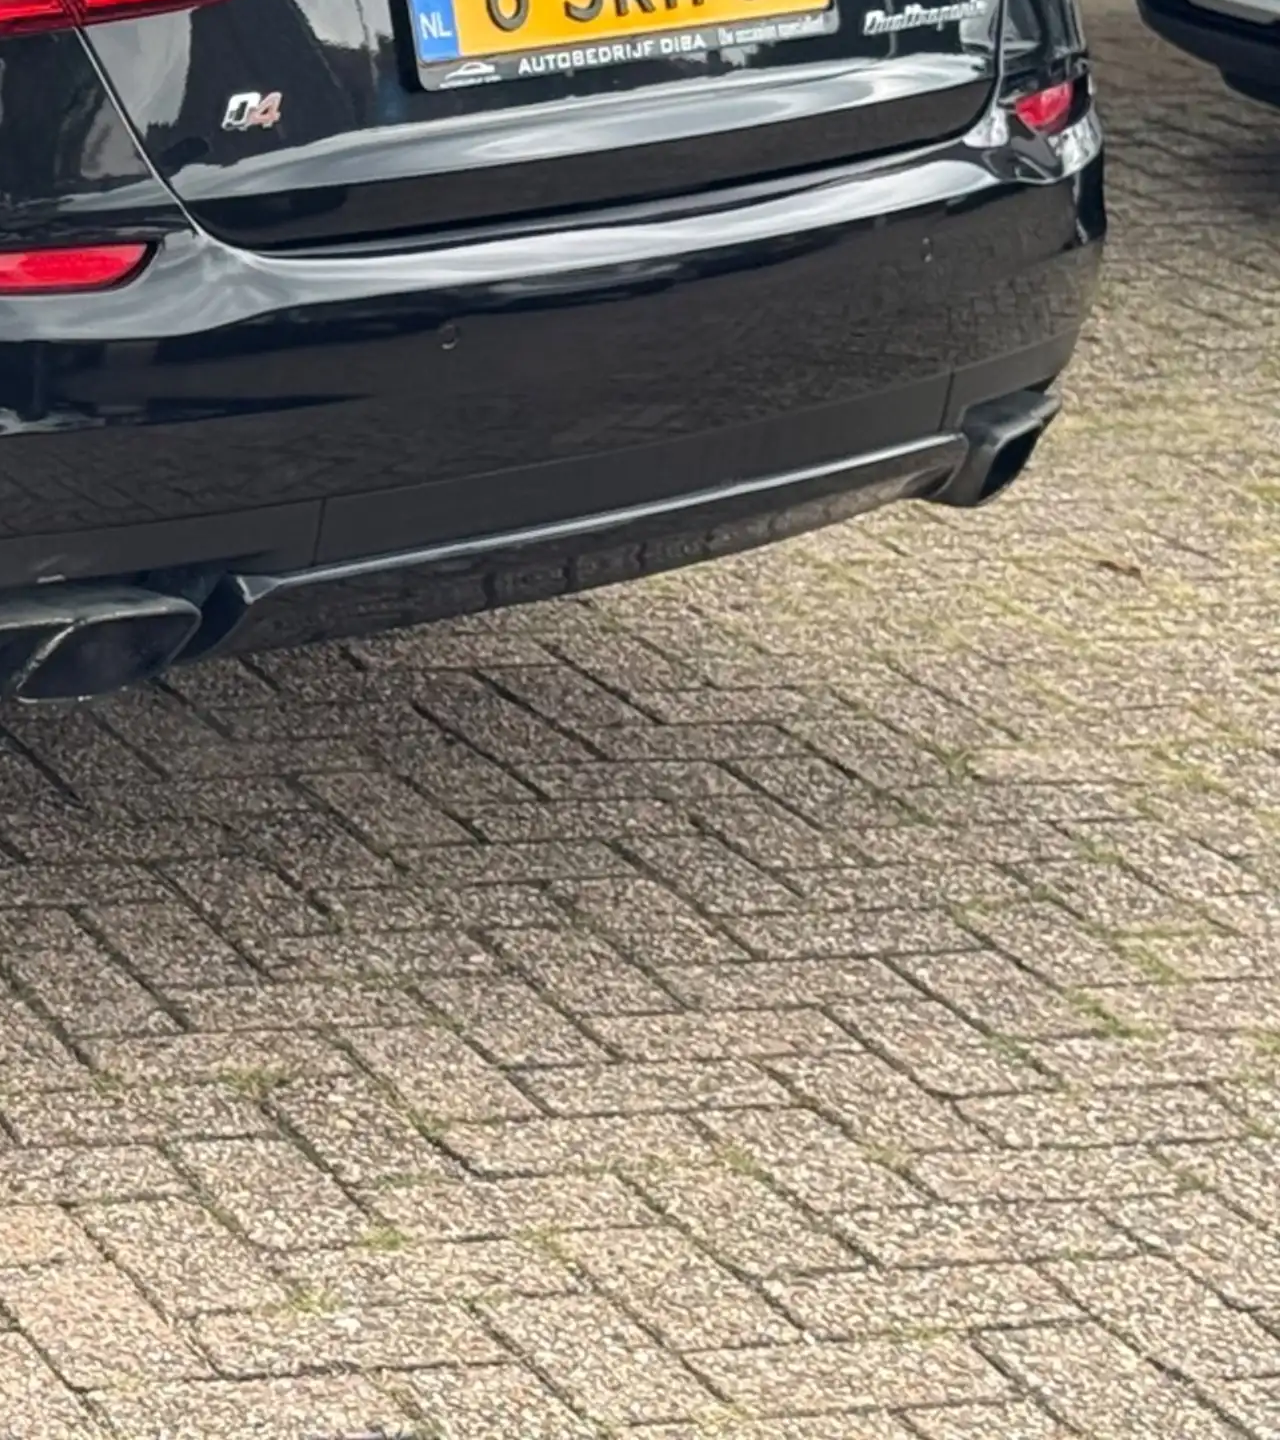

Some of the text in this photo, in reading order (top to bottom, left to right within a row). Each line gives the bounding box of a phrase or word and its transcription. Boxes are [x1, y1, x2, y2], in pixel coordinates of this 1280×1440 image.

[420, 11, 452, 41] NL
[518, 39, 657, 75] AUTOBEDRIJF
[659, 33, 707, 55] DIBA
[221, 91, 283, 131] Q4
